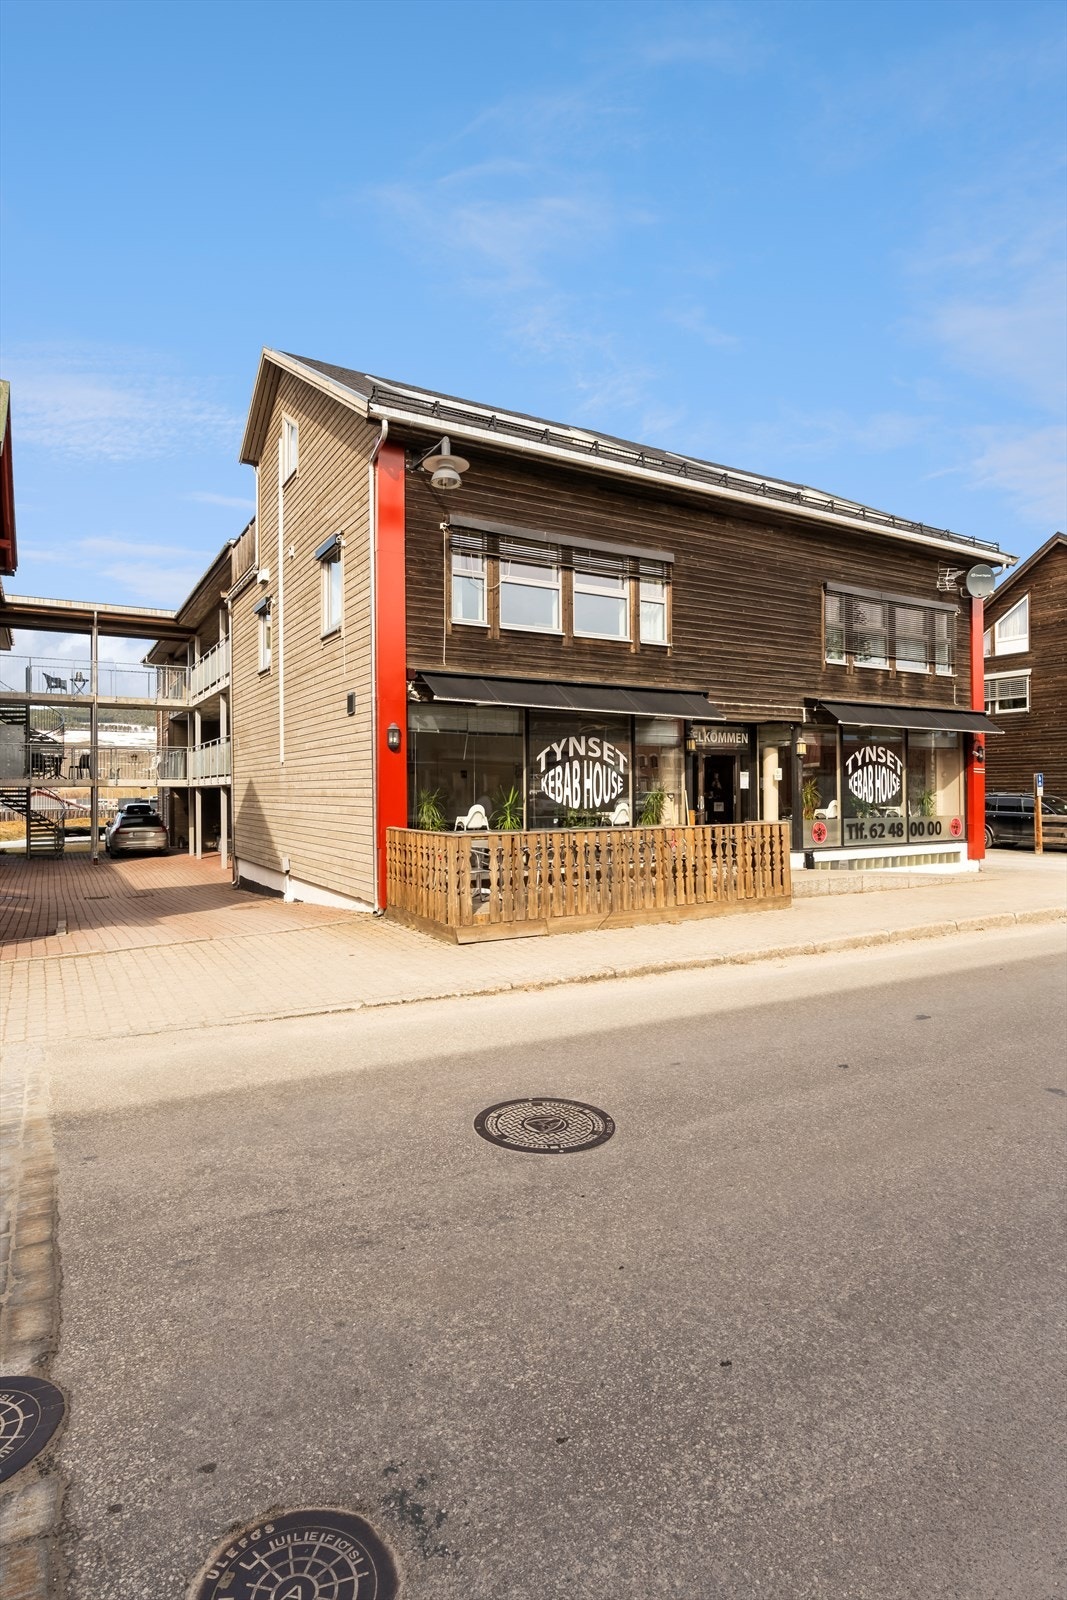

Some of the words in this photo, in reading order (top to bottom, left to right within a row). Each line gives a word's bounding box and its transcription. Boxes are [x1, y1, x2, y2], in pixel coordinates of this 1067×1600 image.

[536, 735, 628, 773] TYNSET
[845, 745, 903, 776] TYNSET
[541, 760, 581, 809] KEBAB
[583, 760, 624, 809] HOUSE
[848, 764, 874, 804] KEBAB
[874, 764, 901, 804] HOUSE
[846, 822, 868, 840] Tlf.
[869, 823, 886, 839] 62
[888, 822, 904, 838] 48
[910, 821, 925, 837] 00
[927, 820, 942, 836] 00
